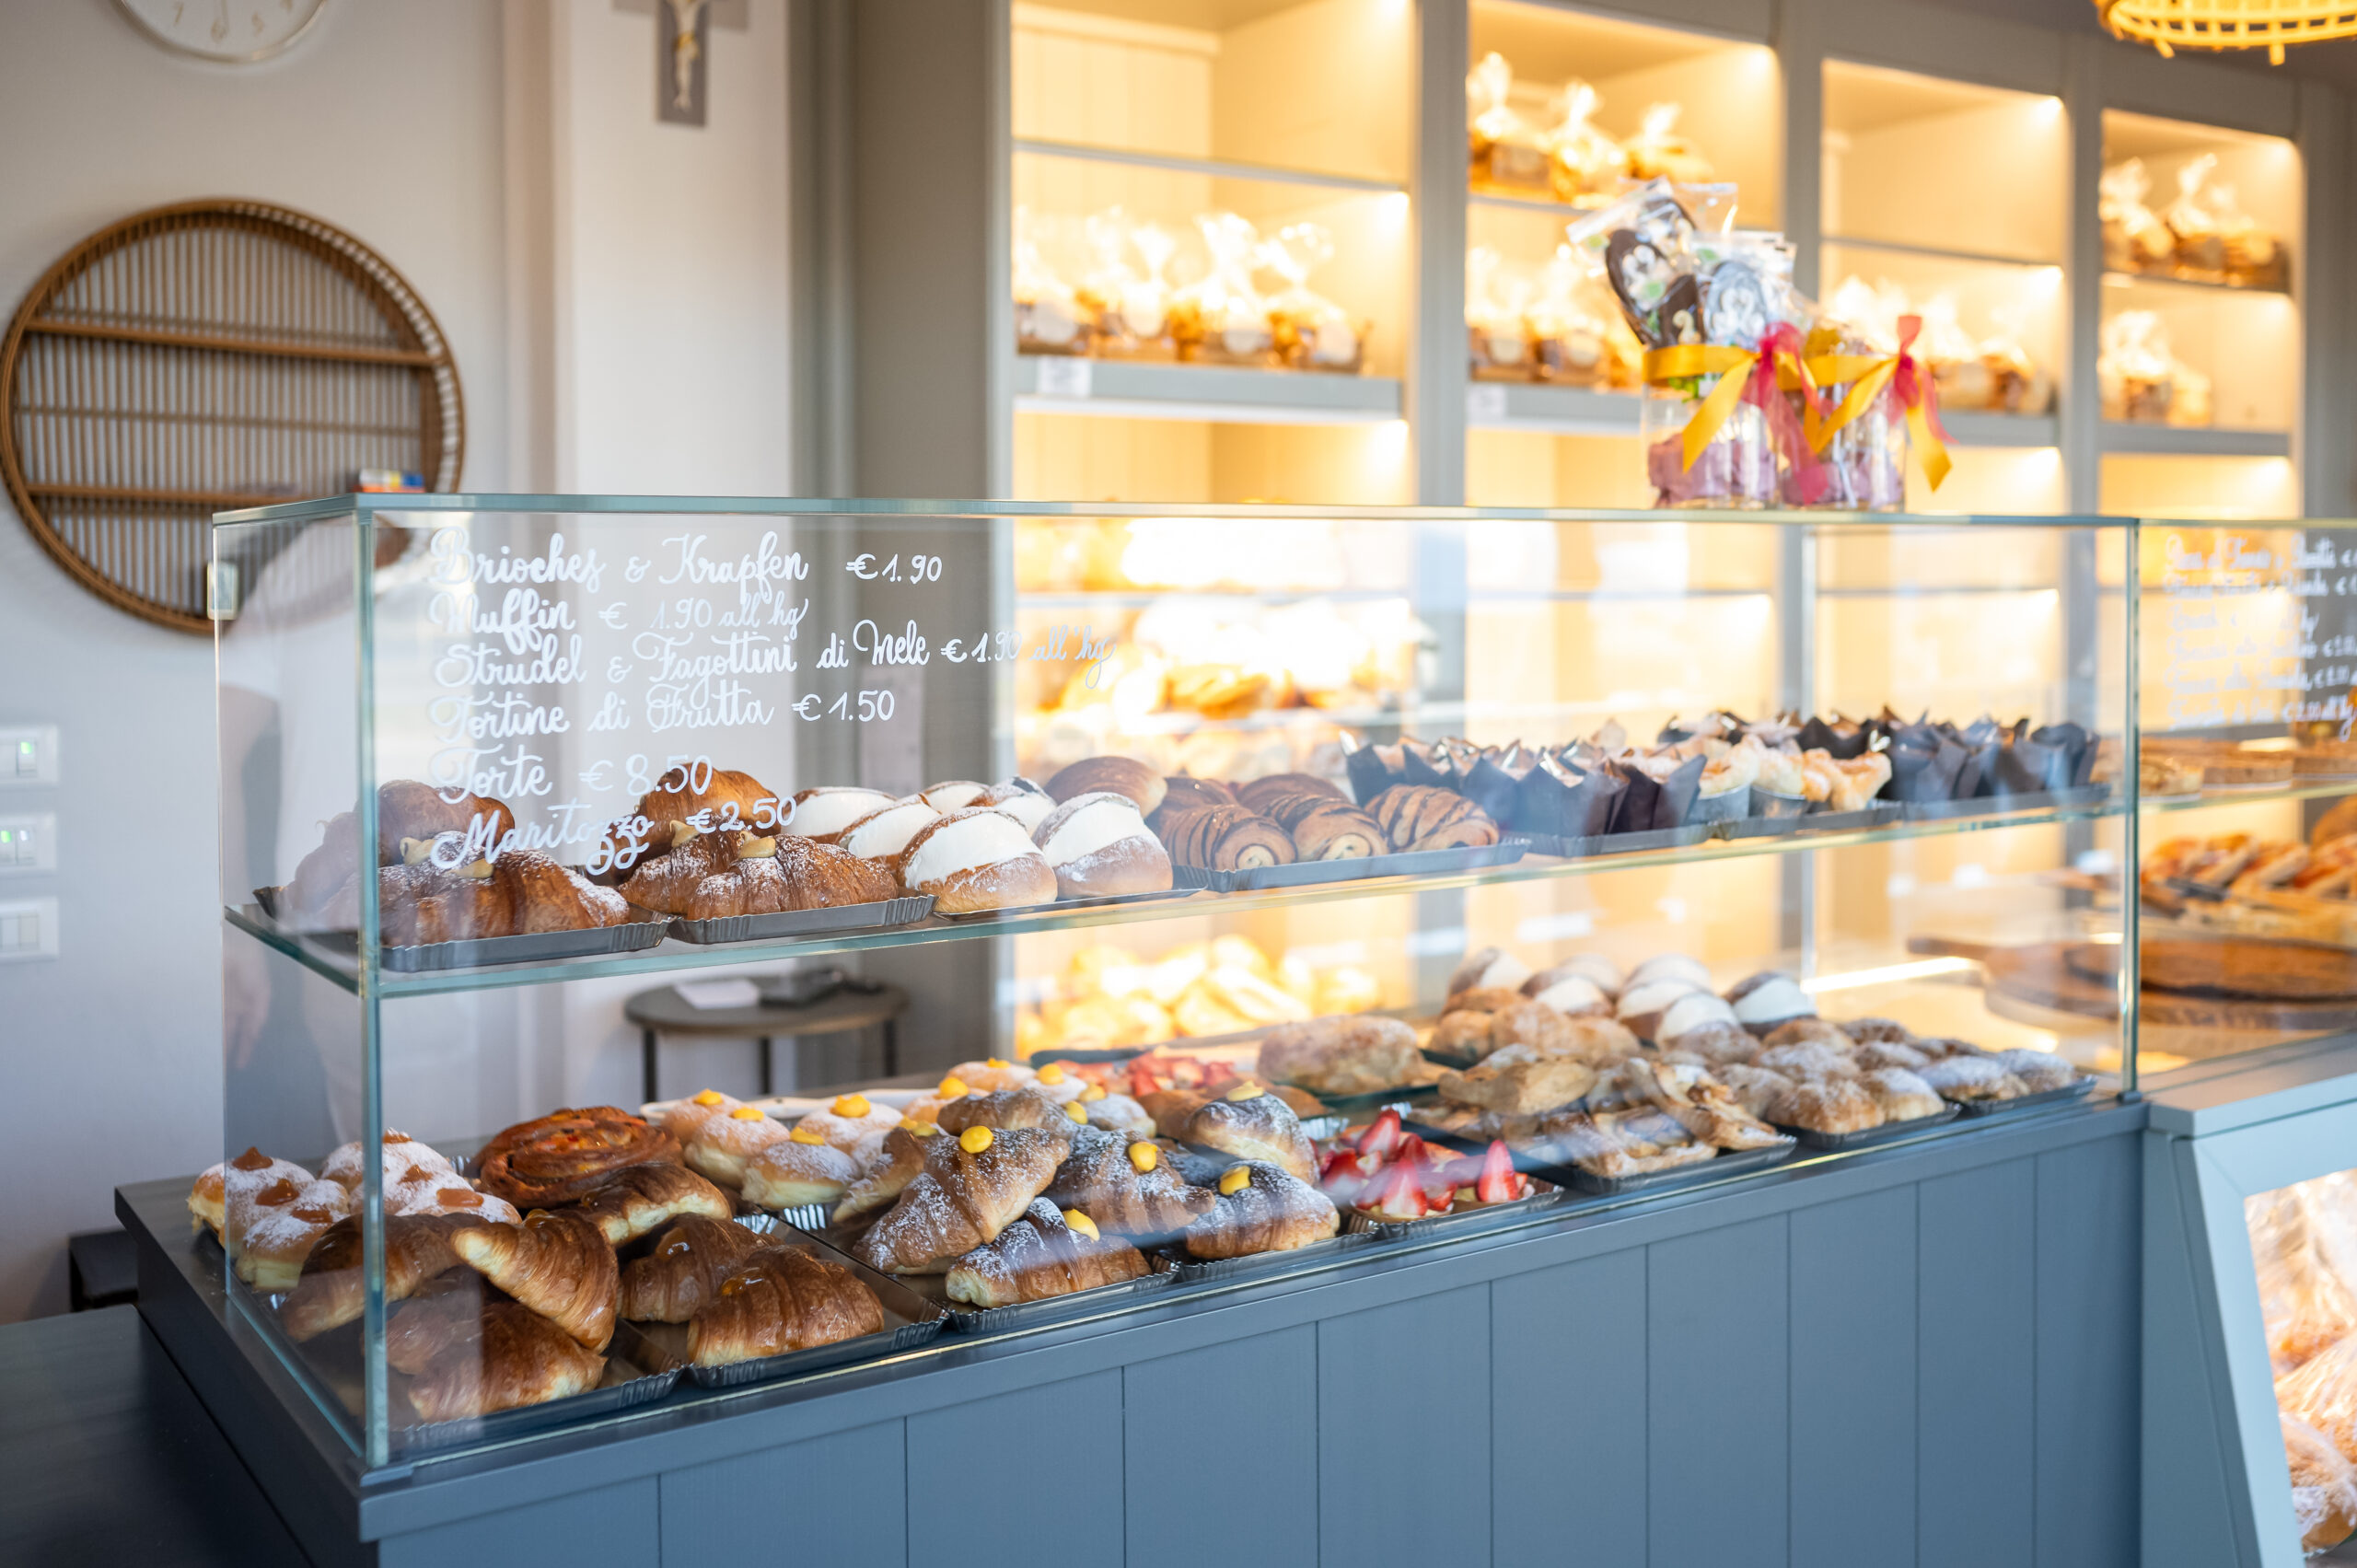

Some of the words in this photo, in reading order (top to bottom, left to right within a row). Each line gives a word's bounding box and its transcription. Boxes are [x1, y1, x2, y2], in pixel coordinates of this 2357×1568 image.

[427, 526, 607, 594] Brioches
[624, 556, 652, 583] &
[658, 531, 809, 605] Krapfen
[428, 587, 576, 655] Muffin
[434, 633, 587, 688] Strudel
[607, 656, 633, 683] &
[632, 632, 797, 710] Fagottini
[817, 632, 849, 668] di
[853, 619, 930, 666] Mele
[430, 691, 570, 744] Tortine
[587, 691, 630, 731] di
[645, 679, 775, 733] Frutta
[432, 743, 553, 804] Torte
[429, 797, 655, 876] Maritozzo
